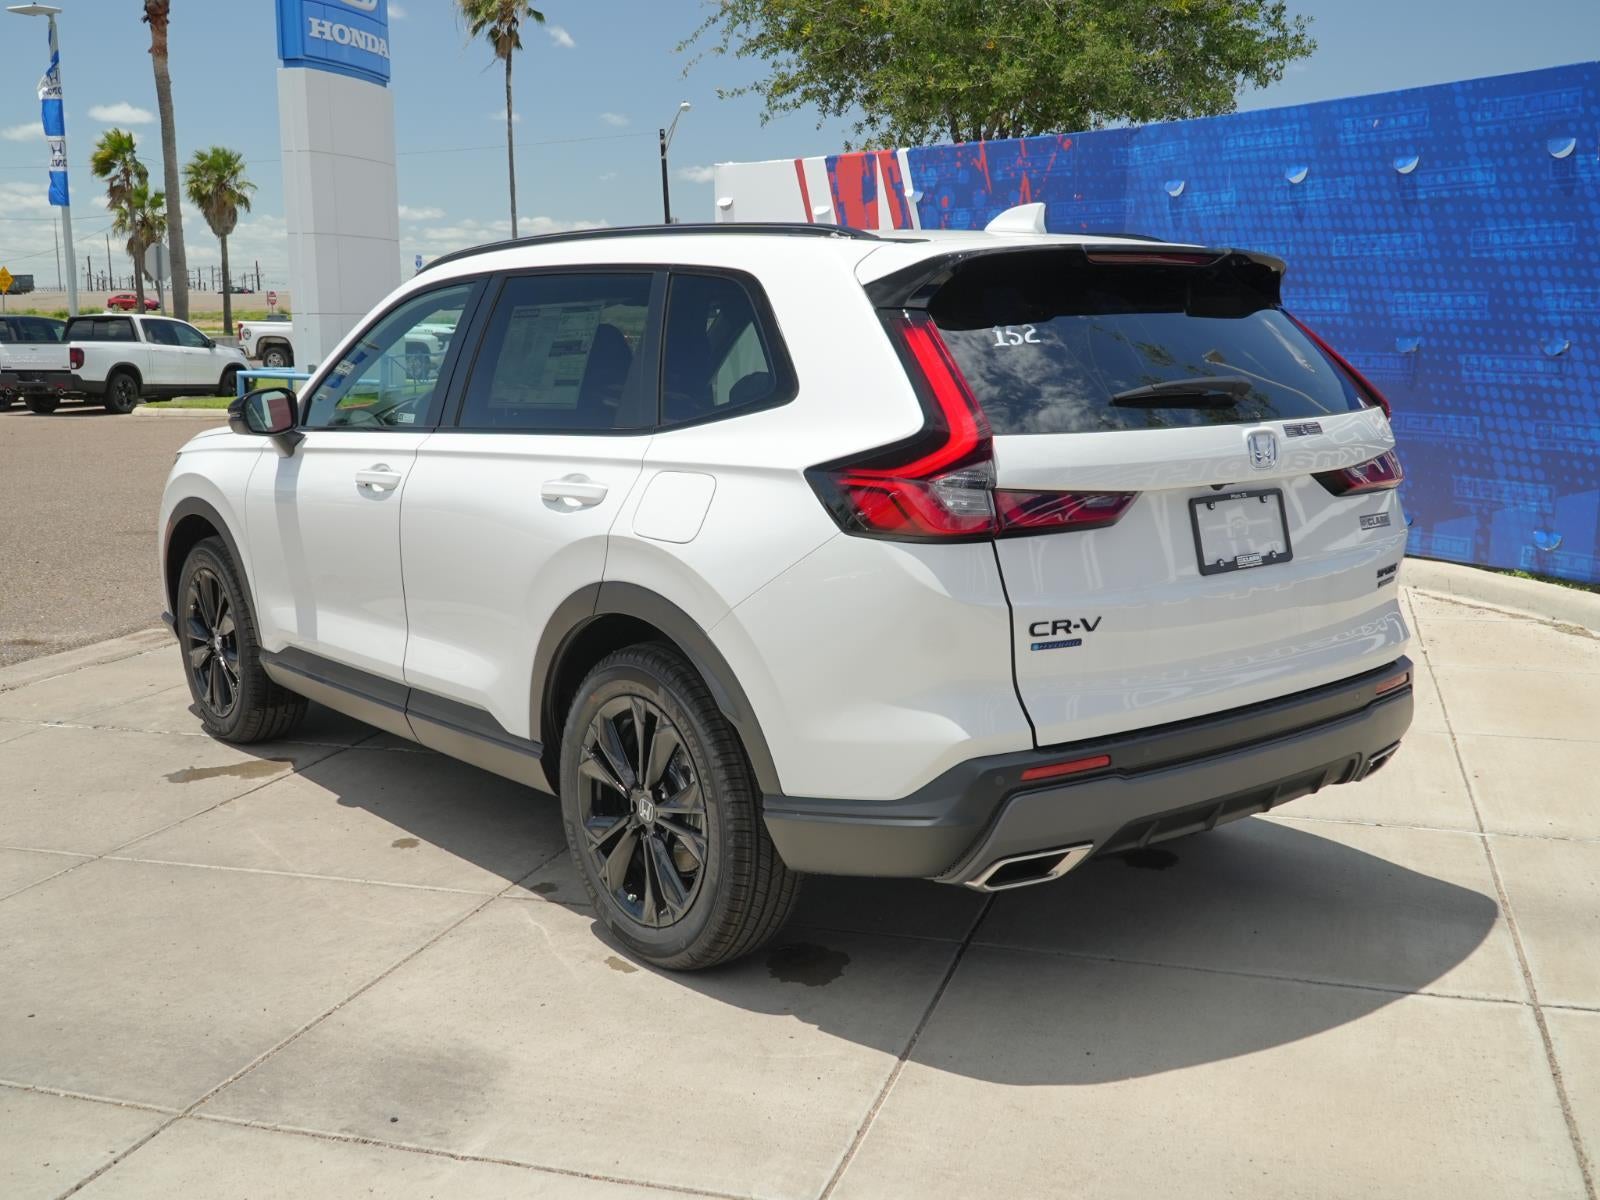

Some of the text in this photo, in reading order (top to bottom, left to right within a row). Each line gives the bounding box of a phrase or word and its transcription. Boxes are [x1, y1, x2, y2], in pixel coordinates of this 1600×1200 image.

[308, 16, 390, 59] HONDA
[992, 324, 1041, 346] 152
[1028, 616, 1102, 637] CR-V
